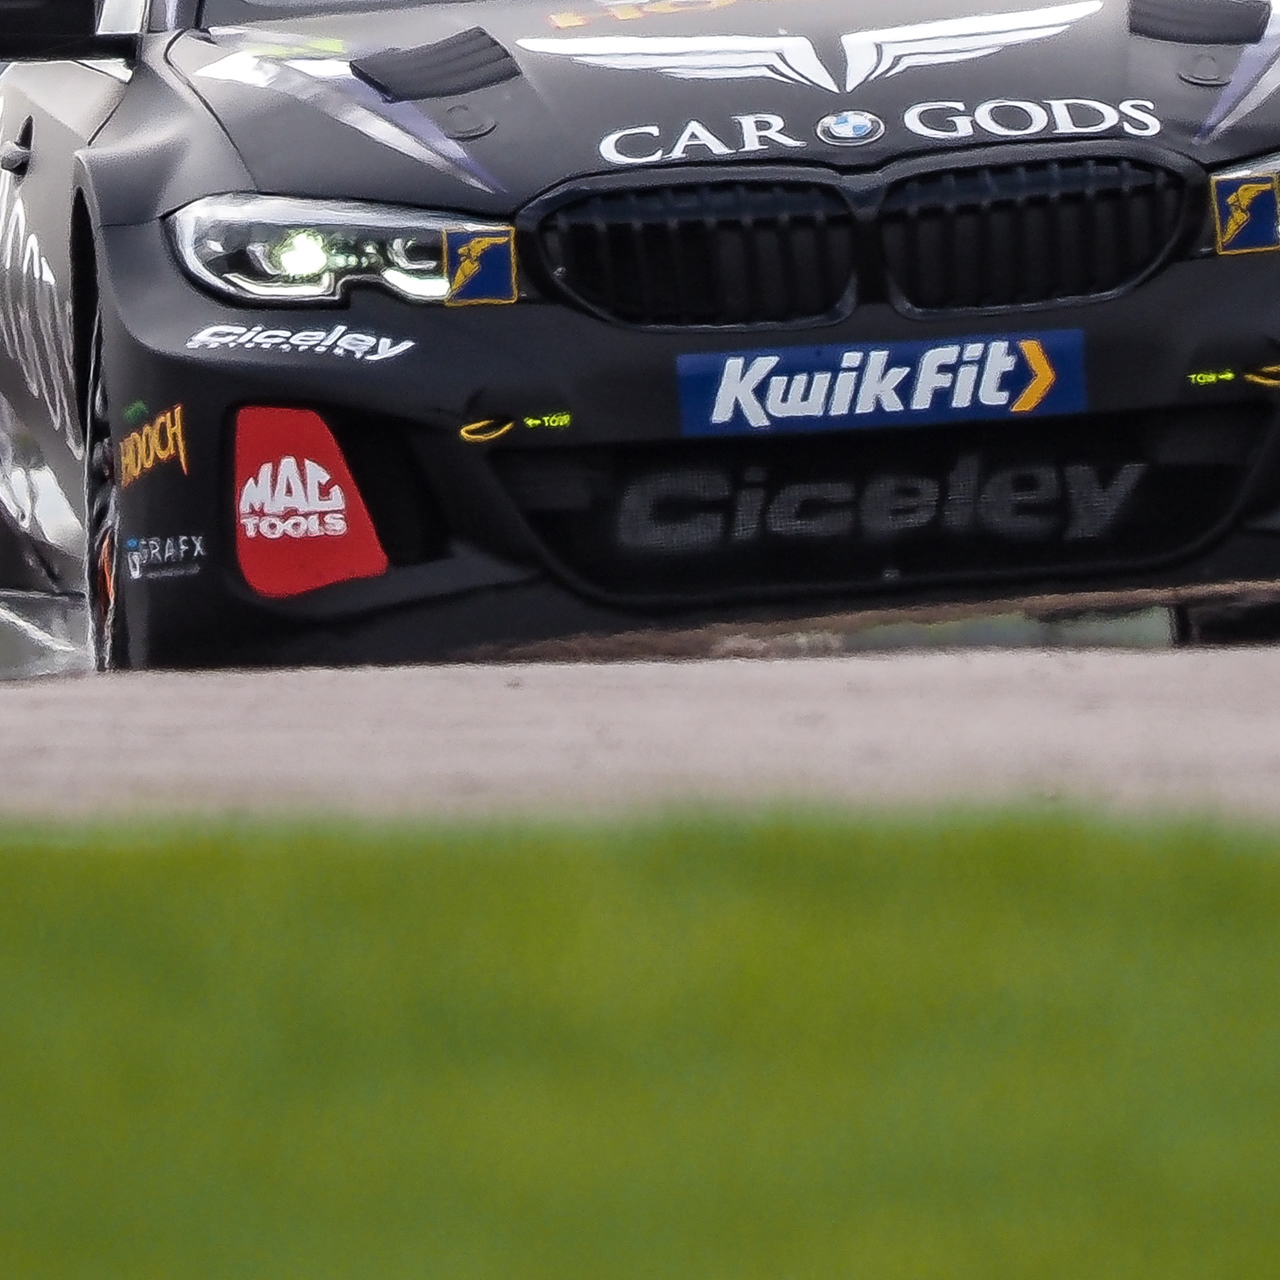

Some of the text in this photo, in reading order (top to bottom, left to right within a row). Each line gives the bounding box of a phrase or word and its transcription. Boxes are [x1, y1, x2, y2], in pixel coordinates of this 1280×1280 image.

[598, 98, 1162, 165] CAR GODS
[193, 324, 416, 361] Ciceley
[240, 455, 346, 515] MAC
[620, 455, 1150, 556] Ciceley
[239, 512, 347, 539] TOOLS
